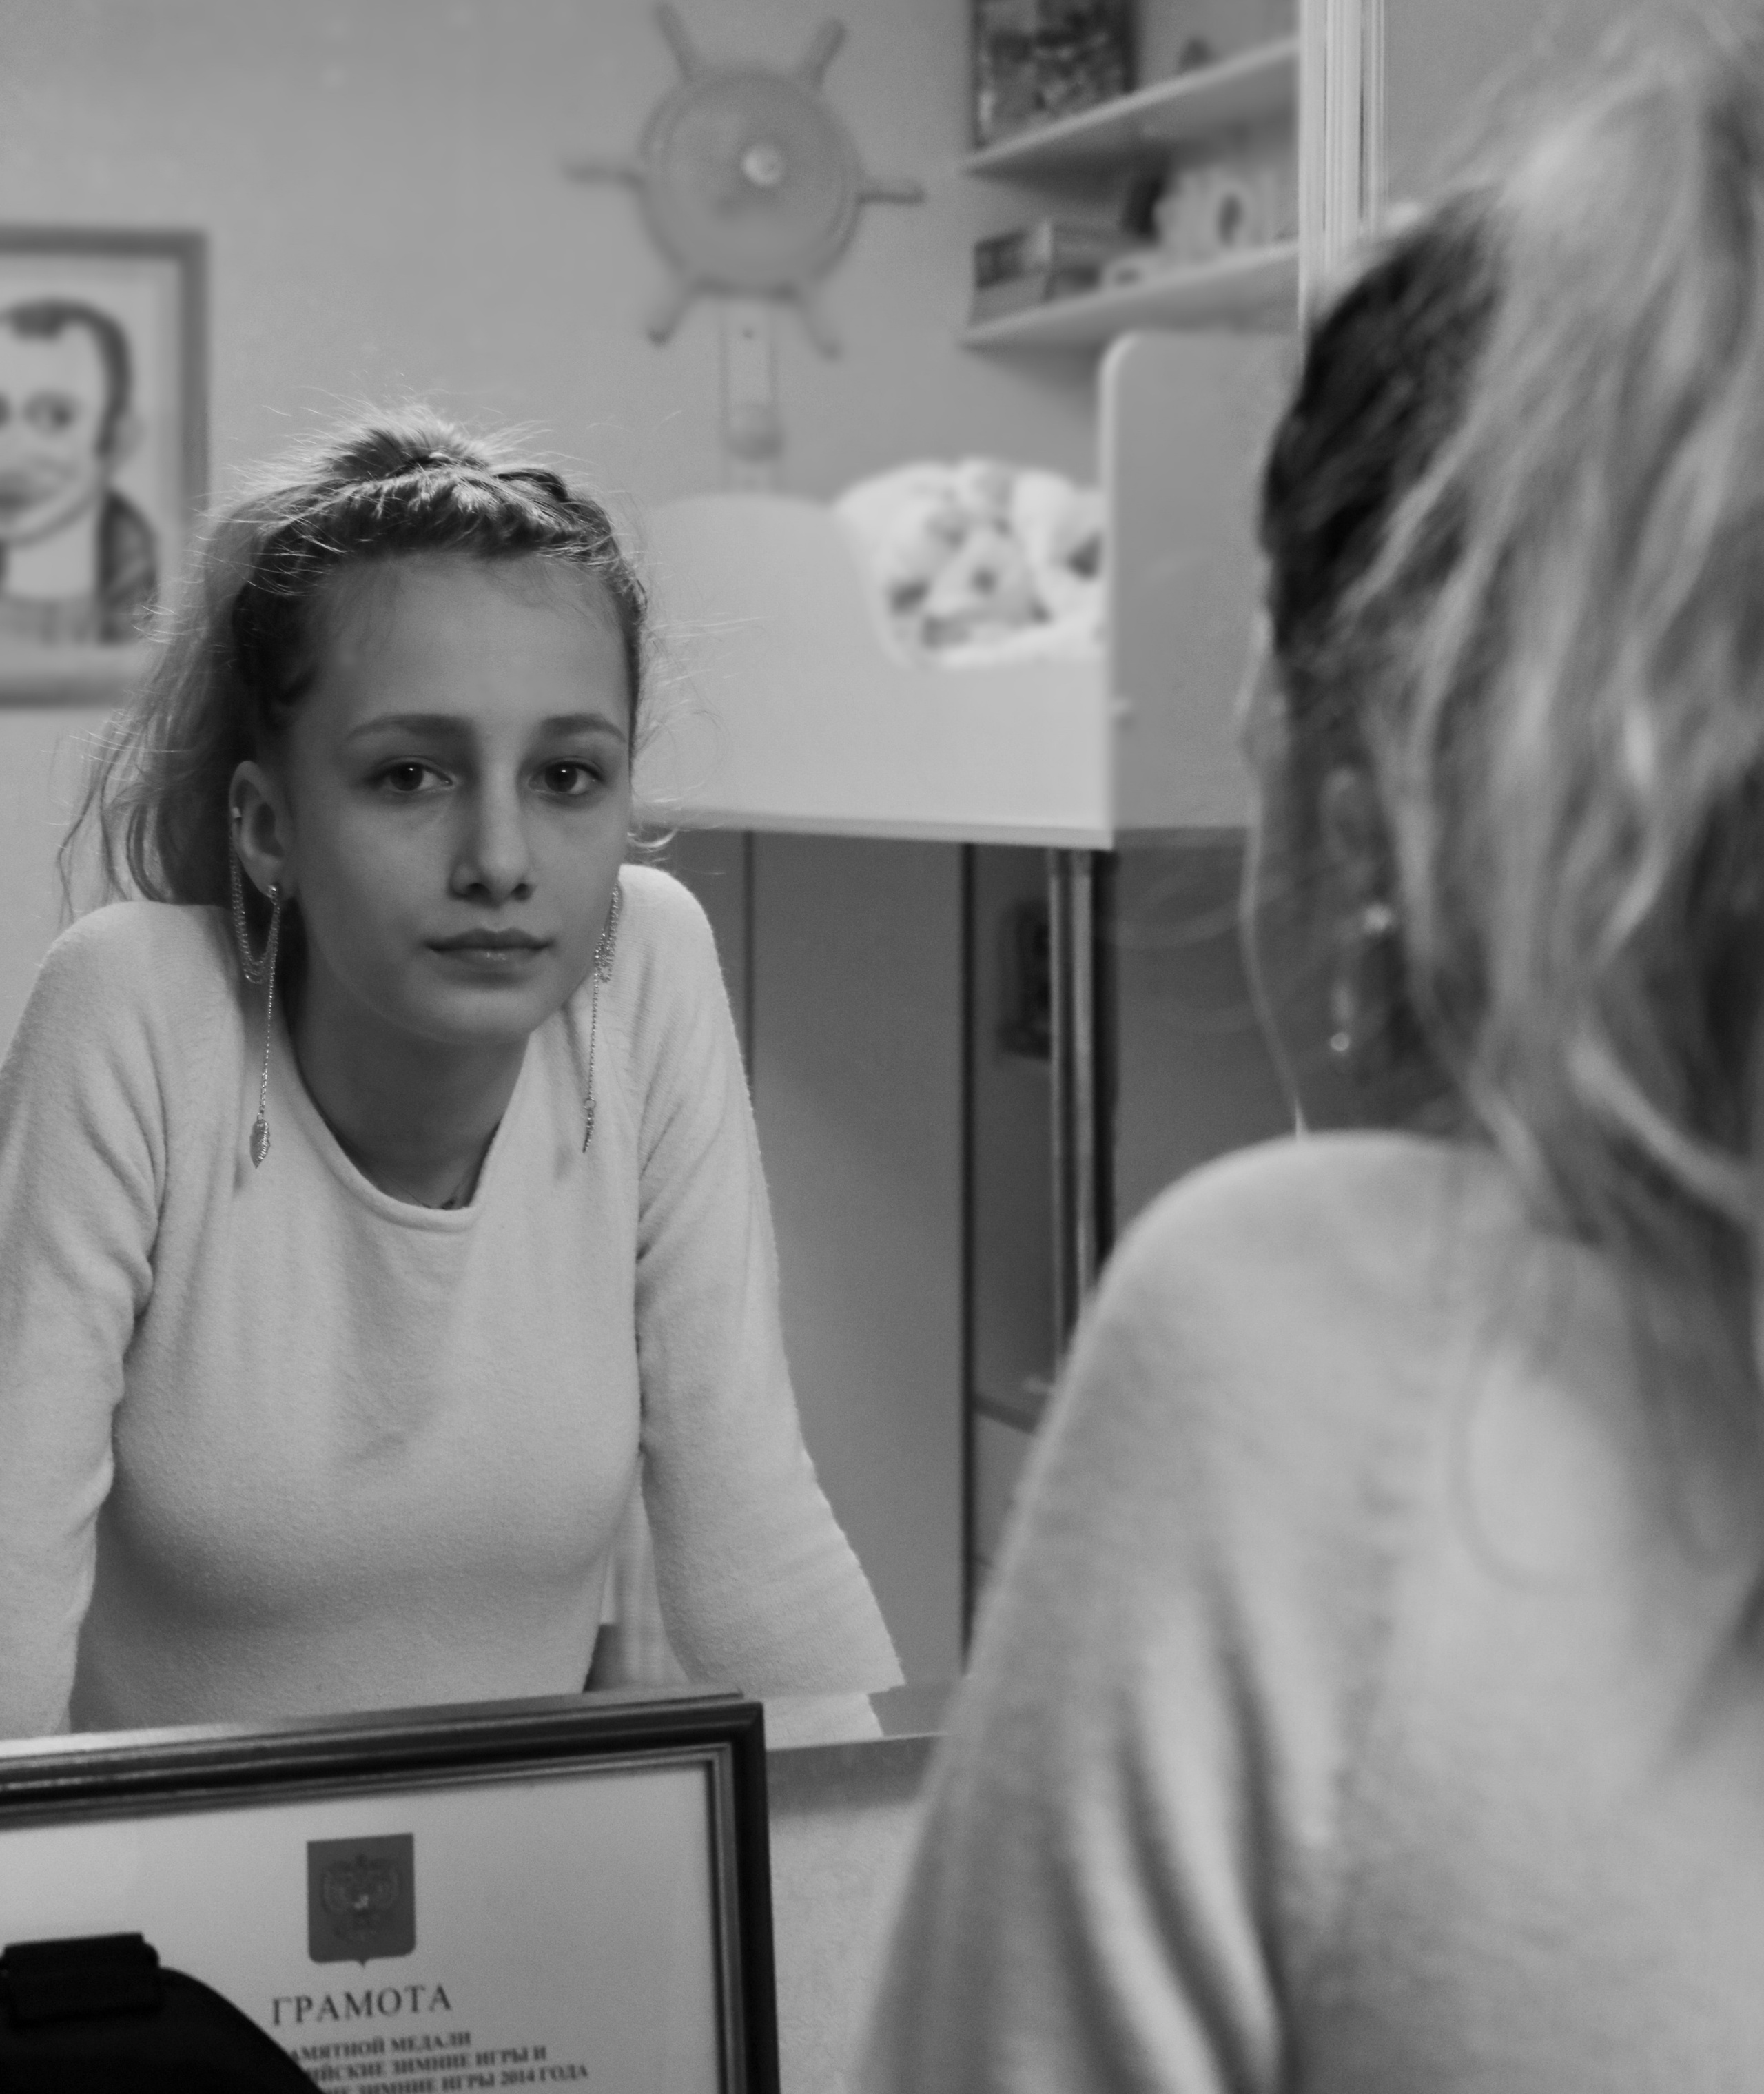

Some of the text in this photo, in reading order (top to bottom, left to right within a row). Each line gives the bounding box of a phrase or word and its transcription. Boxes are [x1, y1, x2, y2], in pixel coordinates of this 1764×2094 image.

[273, 1982, 451, 2026] ГРАМОТА
[390, 2031, 471, 2052] МЕДАЛИ
[475, 2047, 529, 2066] ИГРЫ
[533, 2044, 546, 2062] И
[442, 2073, 495, 2093] ИГРЫ
[500, 2068, 535, 2086] 2014
[539, 2064, 588, 2082] ГОДА
